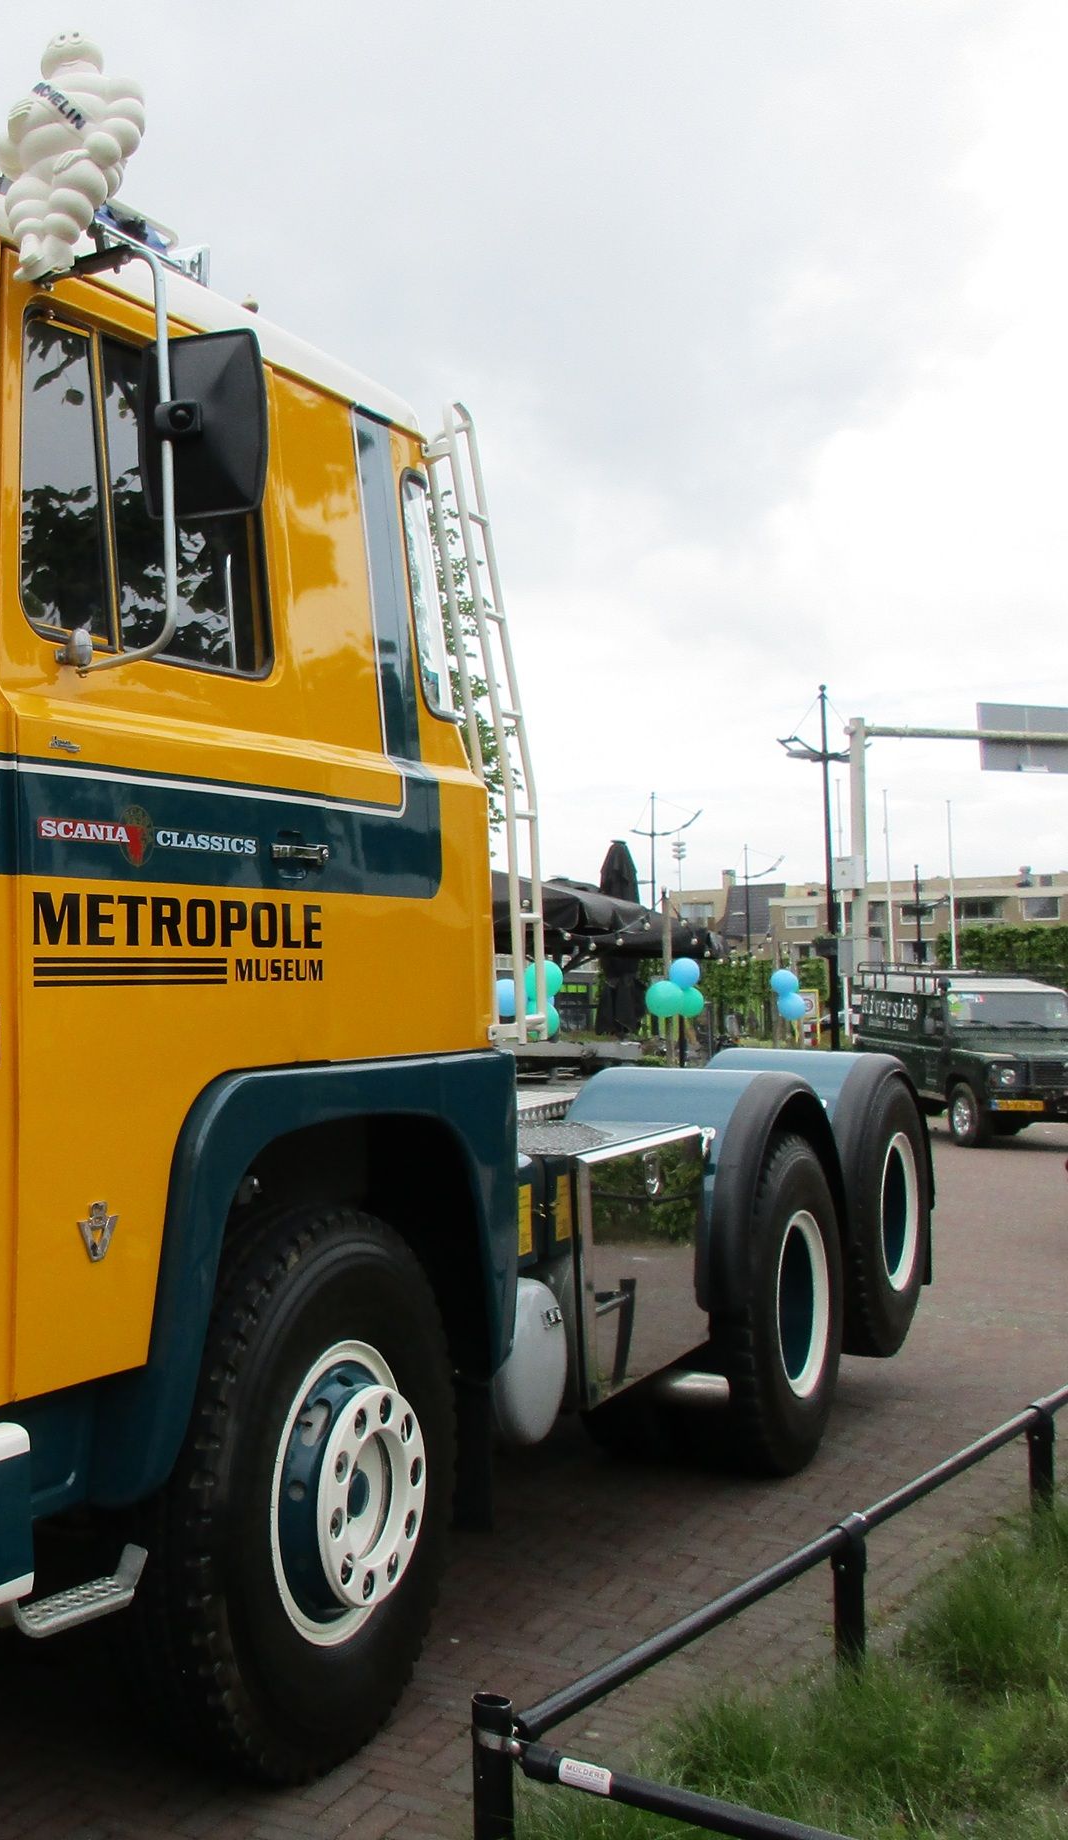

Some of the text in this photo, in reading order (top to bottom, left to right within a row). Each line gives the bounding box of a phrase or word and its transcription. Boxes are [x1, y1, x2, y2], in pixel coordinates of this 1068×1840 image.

[40, 820, 257, 855] SCANIA CLASSICS
[32, 891, 323, 949] METROPOLE
[235, 958, 323, 982] MUSEUM
[862, 994, 918, 1021] Riverside
[565, 1763, 606, 1780] MULDERS
